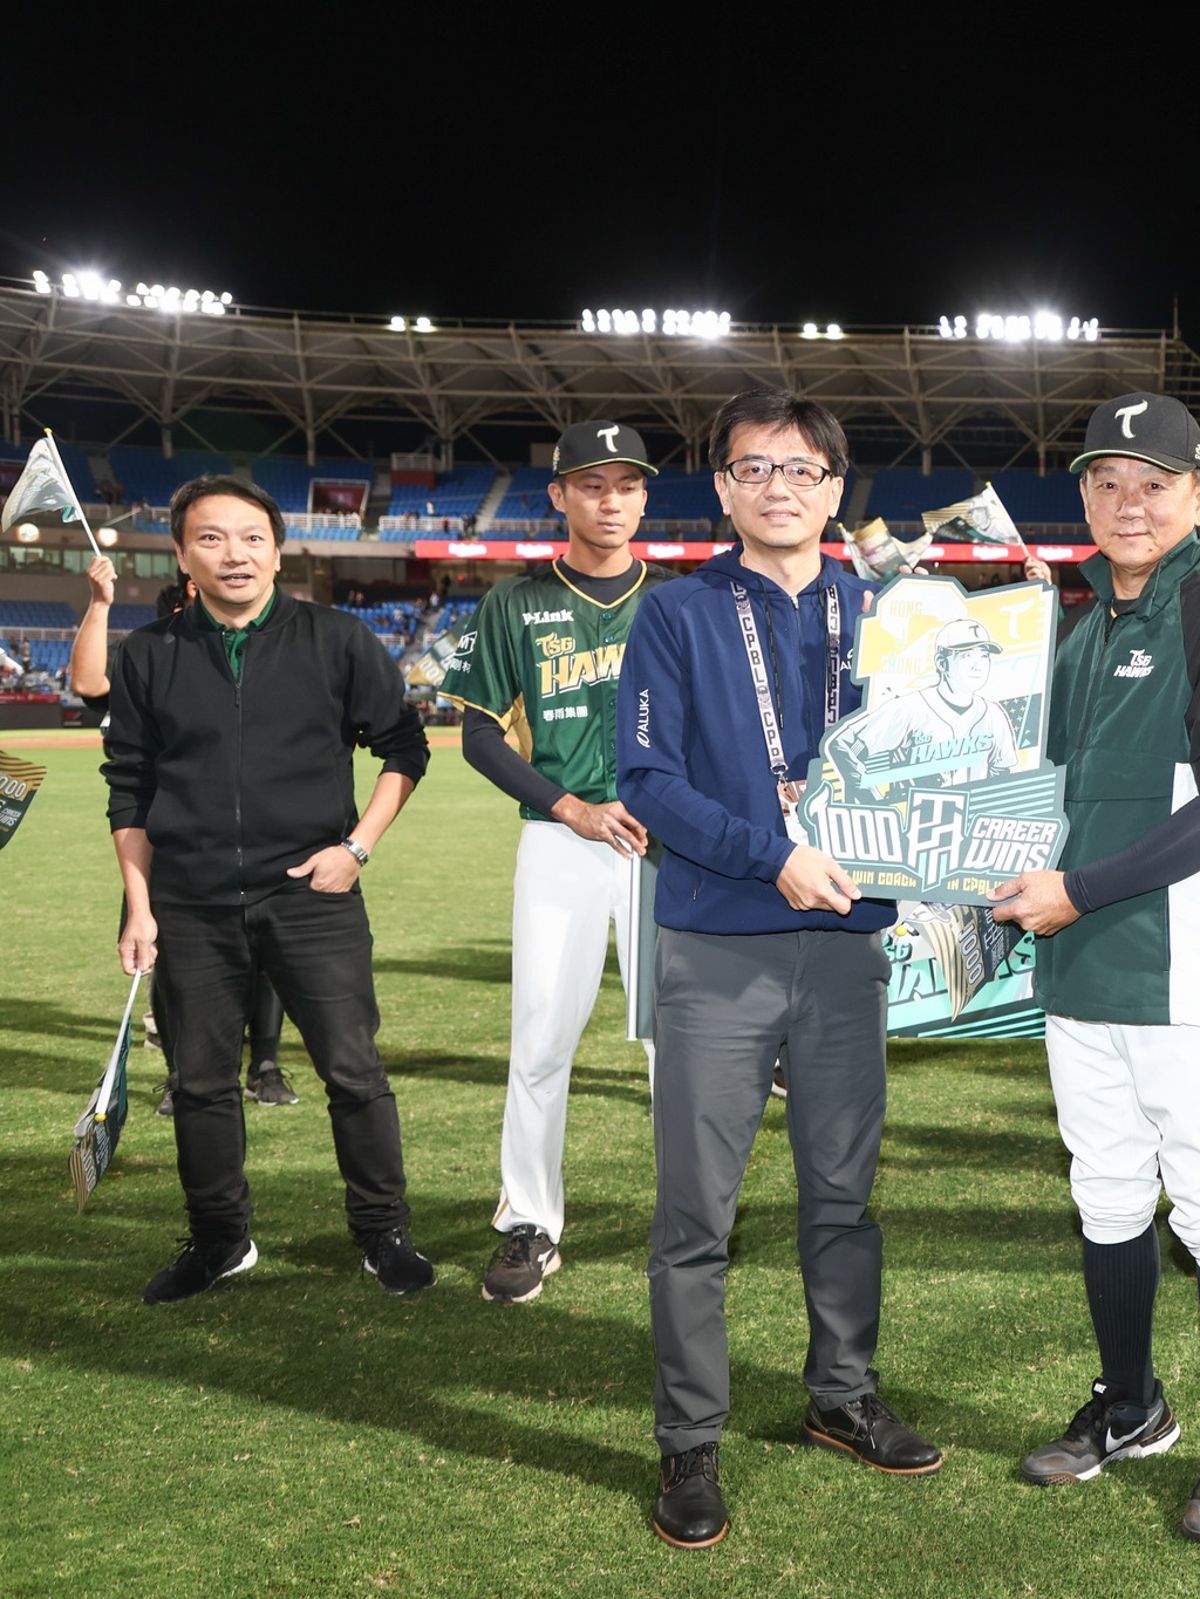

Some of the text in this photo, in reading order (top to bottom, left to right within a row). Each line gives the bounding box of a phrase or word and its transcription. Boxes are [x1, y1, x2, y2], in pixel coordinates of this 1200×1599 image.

[1114, 400, 1149, 439] T
[597, 425, 620, 453] T
[536, 632, 576, 659] TSG
[742, 617, 765, 683] CPBL
[1129, 649, 1152, 669] TSG
[537, 643, 627, 699] HAW
[1113, 664, 1155, 678] HAWKS
[640, 688, 650, 733] ALUKA
[909, 732, 996, 765] HAWKS
[0, 776, 27, 798] 000
[809, 786, 903, 862] 1000
[972, 817, 1058, 843] CAREER
[963, 839, 1051, 873] WINS
[852, 869, 875, 885] WIN
[877, 871, 917, 888] COACH
[947, 877, 959, 892] IN
[882, 932, 912, 961] SG
[958, 923, 984, 985] 1000
